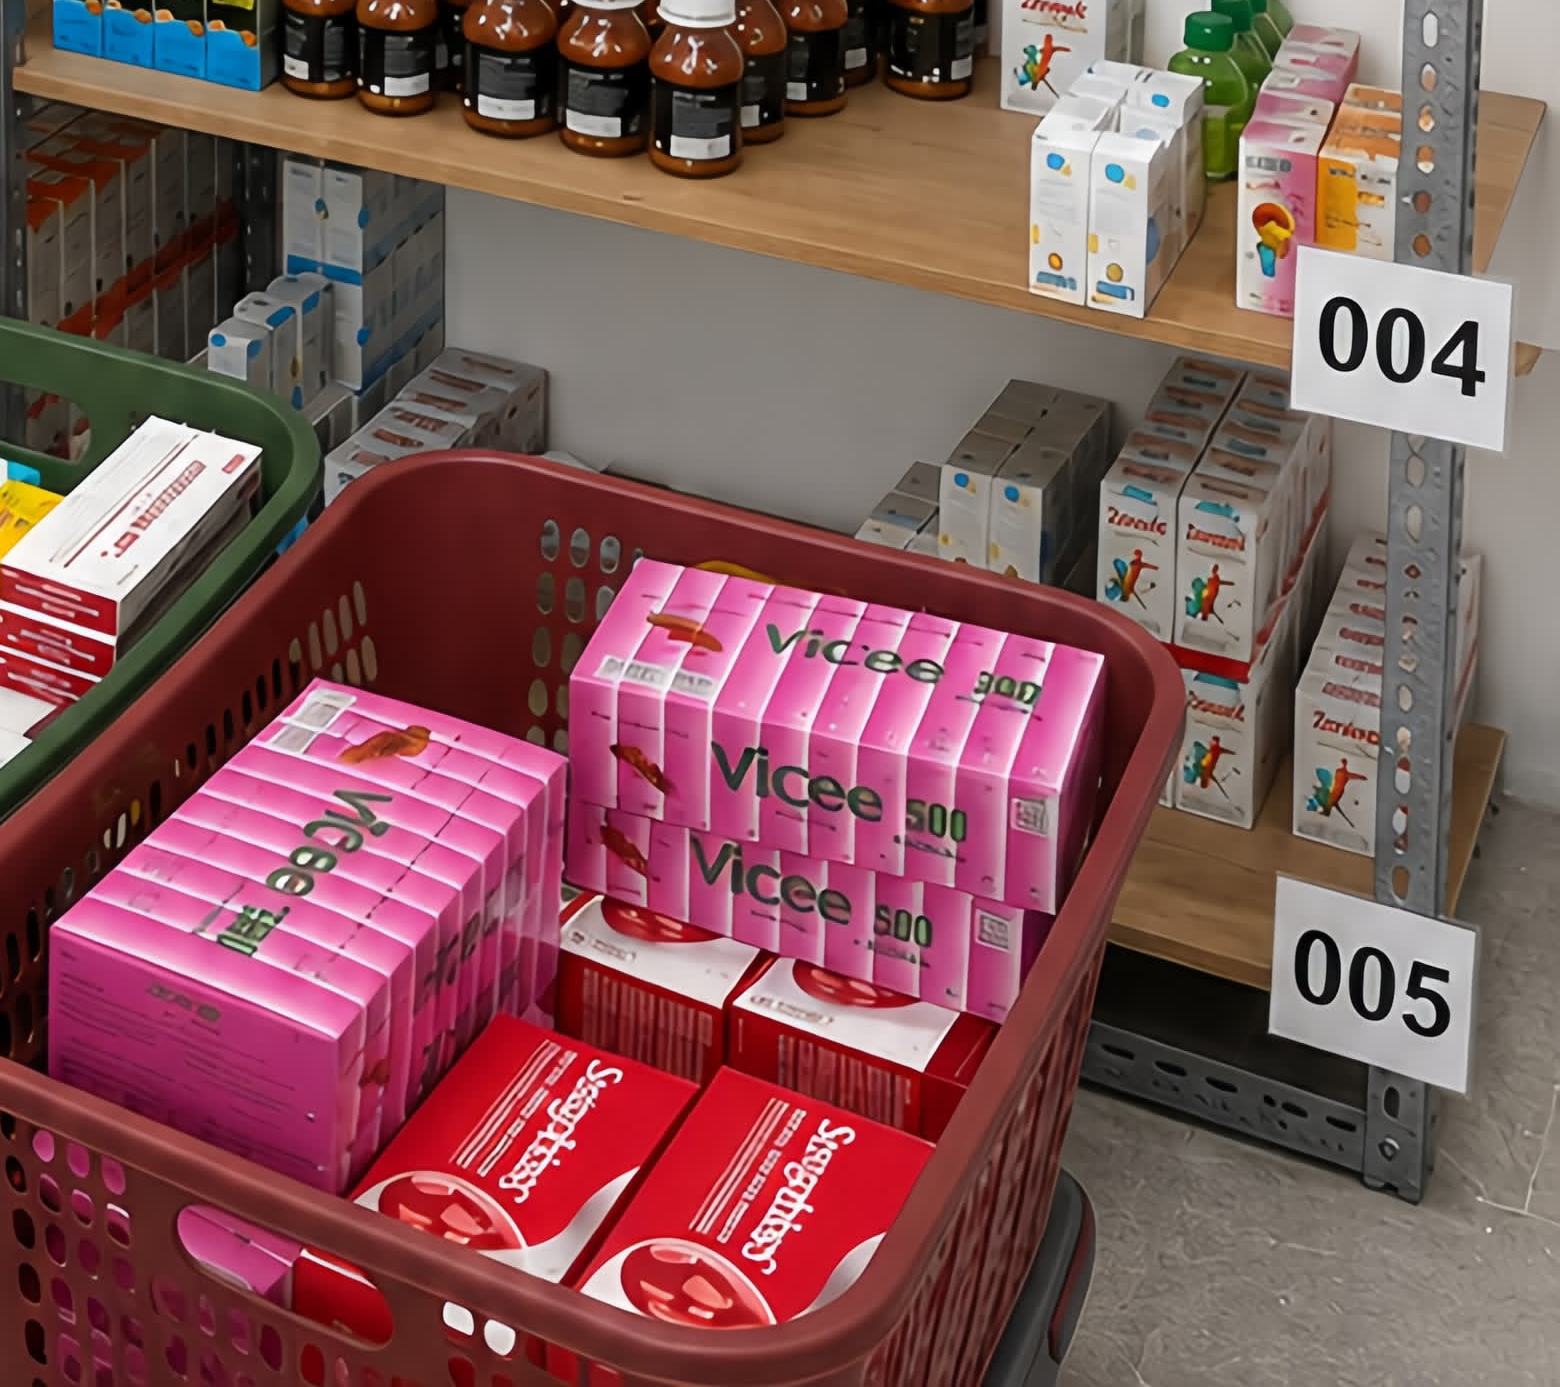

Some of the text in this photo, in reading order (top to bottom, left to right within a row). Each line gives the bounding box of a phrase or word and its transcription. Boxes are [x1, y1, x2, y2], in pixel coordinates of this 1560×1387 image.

[1319, 296, 1486, 396] 004
[766, 623, 944, 684] Vicee
[712, 740, 882, 822] Vicee
[689, 834, 851, 925] Vicee
[1294, 930, 1452, 1038] 005
